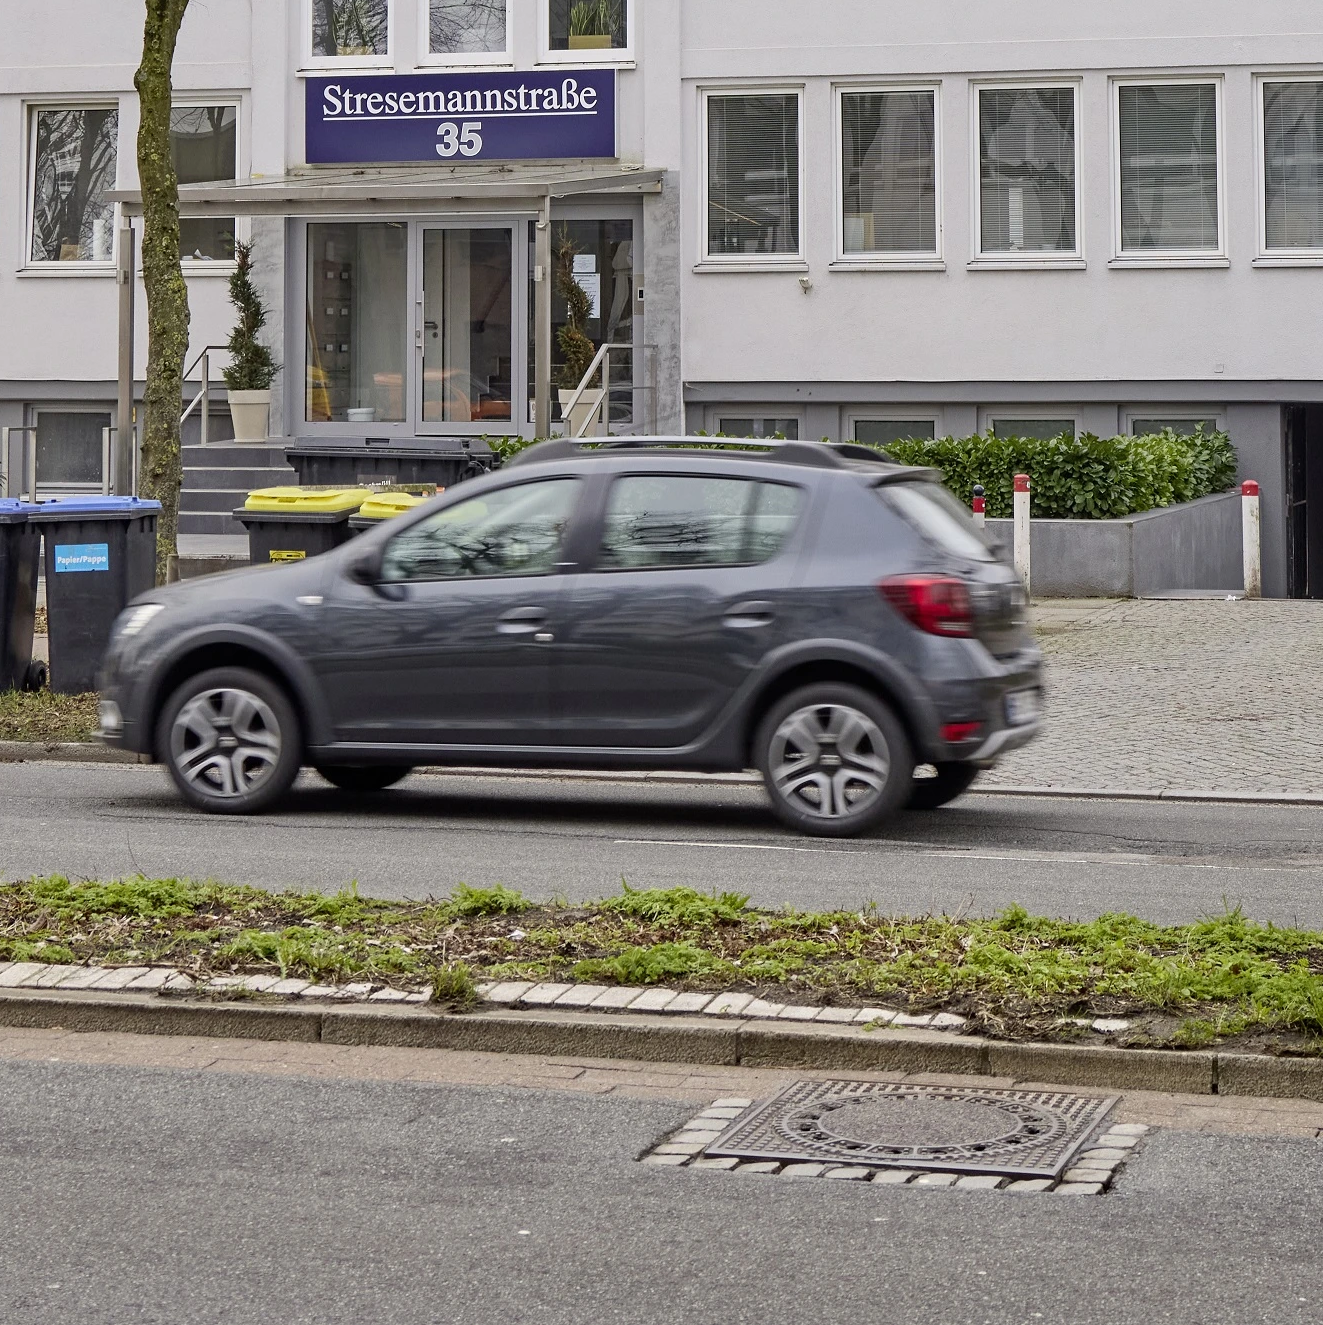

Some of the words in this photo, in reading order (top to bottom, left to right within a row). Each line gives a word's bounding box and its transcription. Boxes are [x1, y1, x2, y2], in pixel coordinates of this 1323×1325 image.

[323, 78, 597, 115] Stresemannstraße
[435, 122, 483, 157] 35
[57, 555, 107, 566] Papier/Pappe
